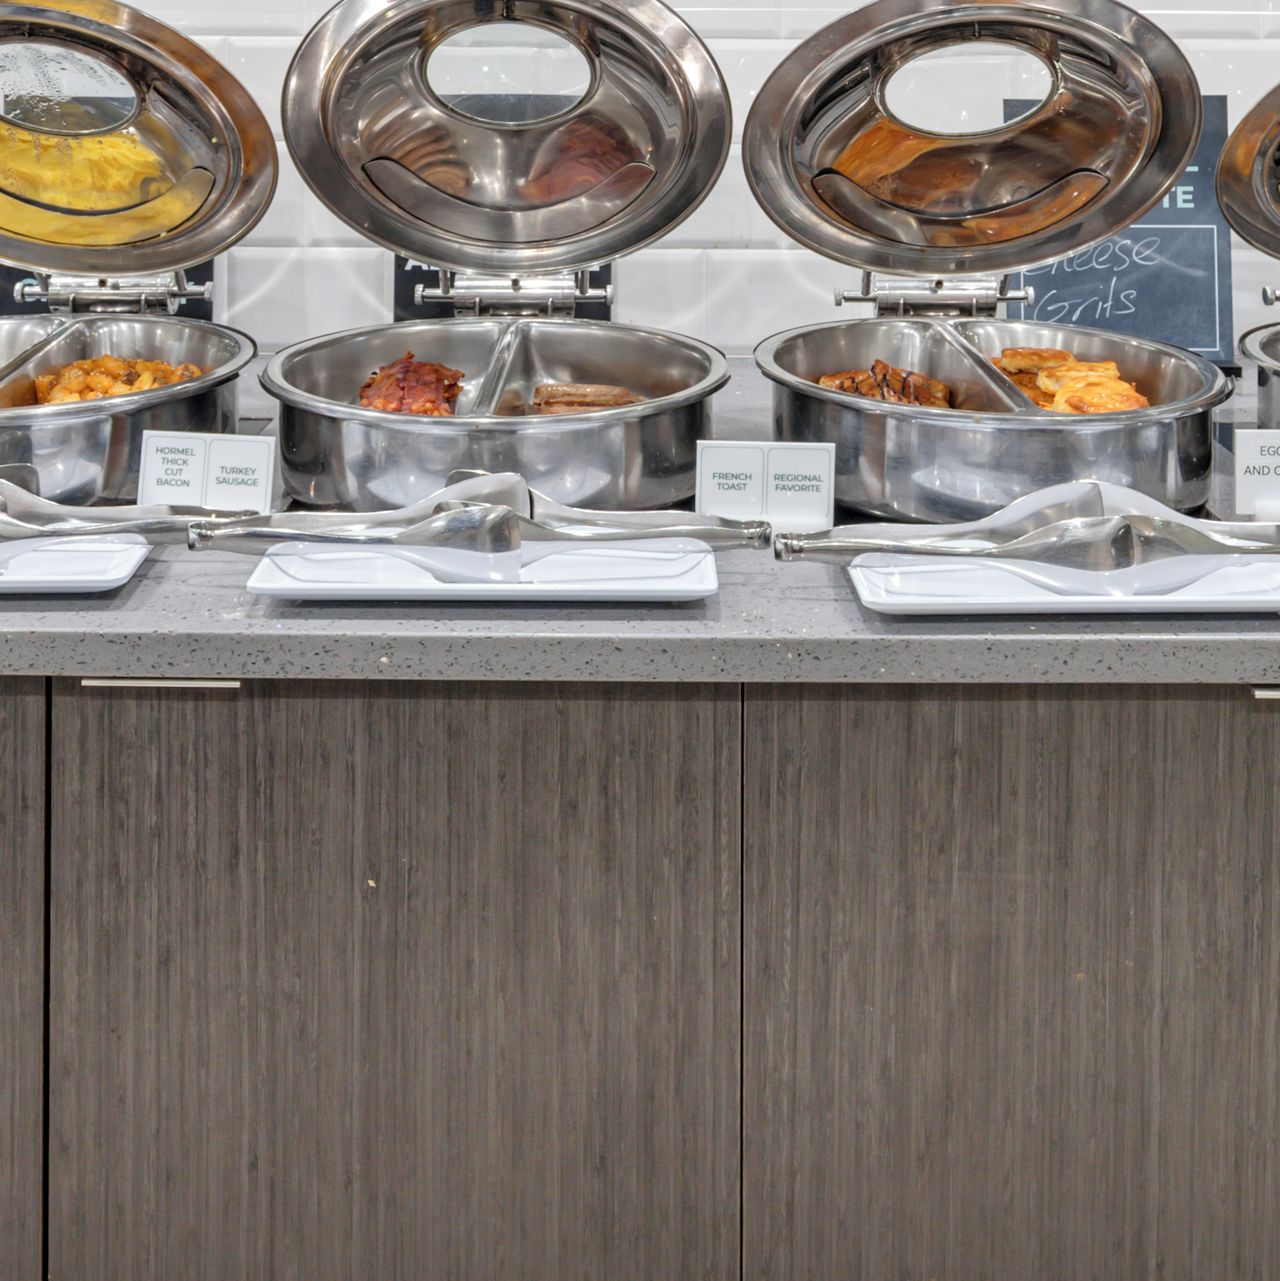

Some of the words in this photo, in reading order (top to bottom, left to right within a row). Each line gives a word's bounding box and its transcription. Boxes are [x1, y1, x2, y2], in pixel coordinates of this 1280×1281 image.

[1024, 237, 1160, 275] eese
[1034, 276, 1136, 322] Grits
[156, 447, 195, 456] HORMEL
[161, 457, 188, 466] THICK
[165, 468, 184, 476] CUT
[220, 466, 256, 476] TURKEY
[1244, 466, 1270, 476] AND
[156, 478, 190, 487] BACON
[216, 477, 258, 486] SAUSAGE
[774, 474, 823, 482] REGIONAL
[775, 484, 821, 492] FAVORITE
